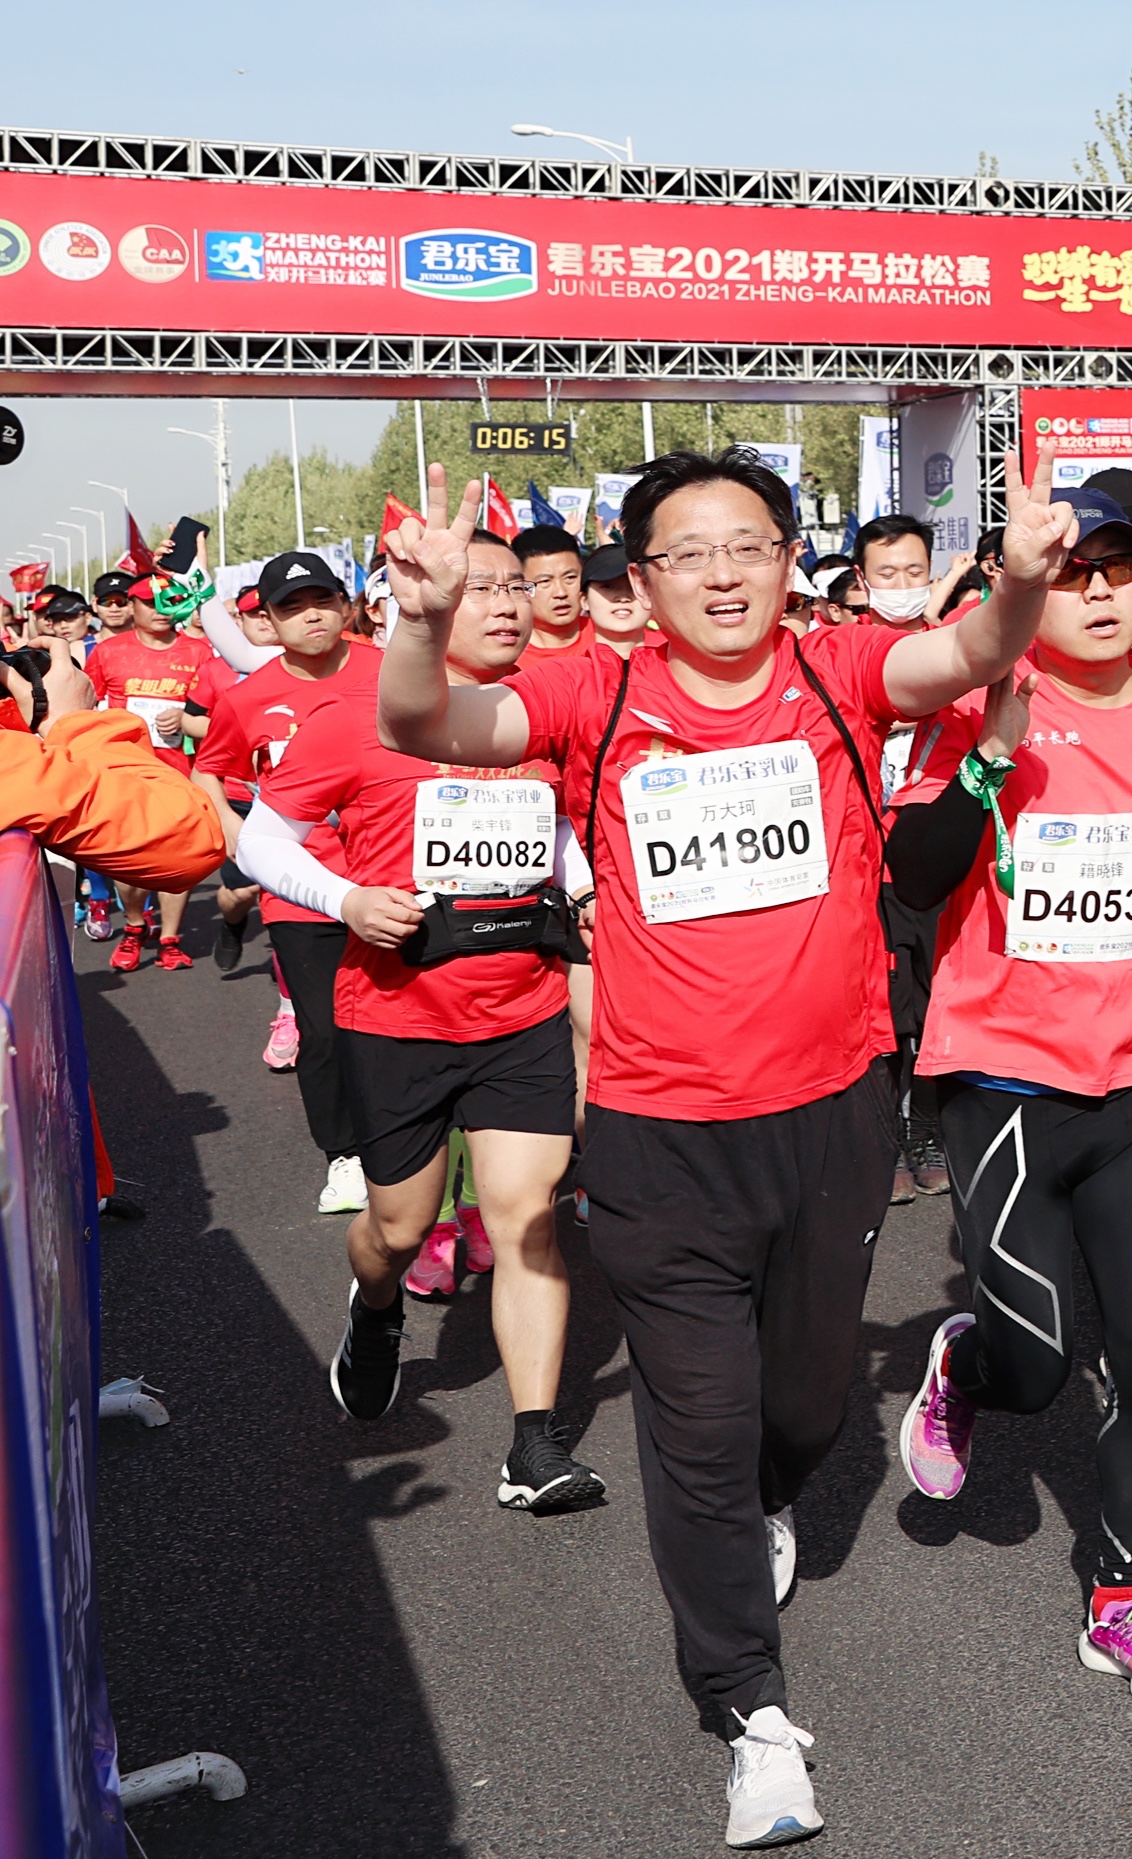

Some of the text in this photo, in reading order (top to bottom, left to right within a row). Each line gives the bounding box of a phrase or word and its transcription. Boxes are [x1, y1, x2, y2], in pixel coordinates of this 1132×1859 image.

[264, 232, 386, 252] ZHENG-KAI
[145, 247, 184, 262] CAA
[264, 250, 387, 269] MARATHON
[420, 240, 521, 273] 君乐宝
[546, 242, 991, 288] 君乐宝2021郑开马拉松赛
[266, 267, 387, 287] 郑开马拉松赛
[419, 272, 474, 283] JUNLEBAO
[547, 279, 992, 307] JUNLEBAO 2021 ZHENG-KAI MARATHON
[476, 427, 567, 450] 0:06:15
[647, 769, 686, 785] 君乐宝
[698, 754, 800, 786] 君乐宝乳业
[472, 788, 542, 804] 君乐宝乳业
[700, 799, 757, 824] 万大珂
[426, 840, 547, 868] D40082
[646, 819, 811, 878] D41800
